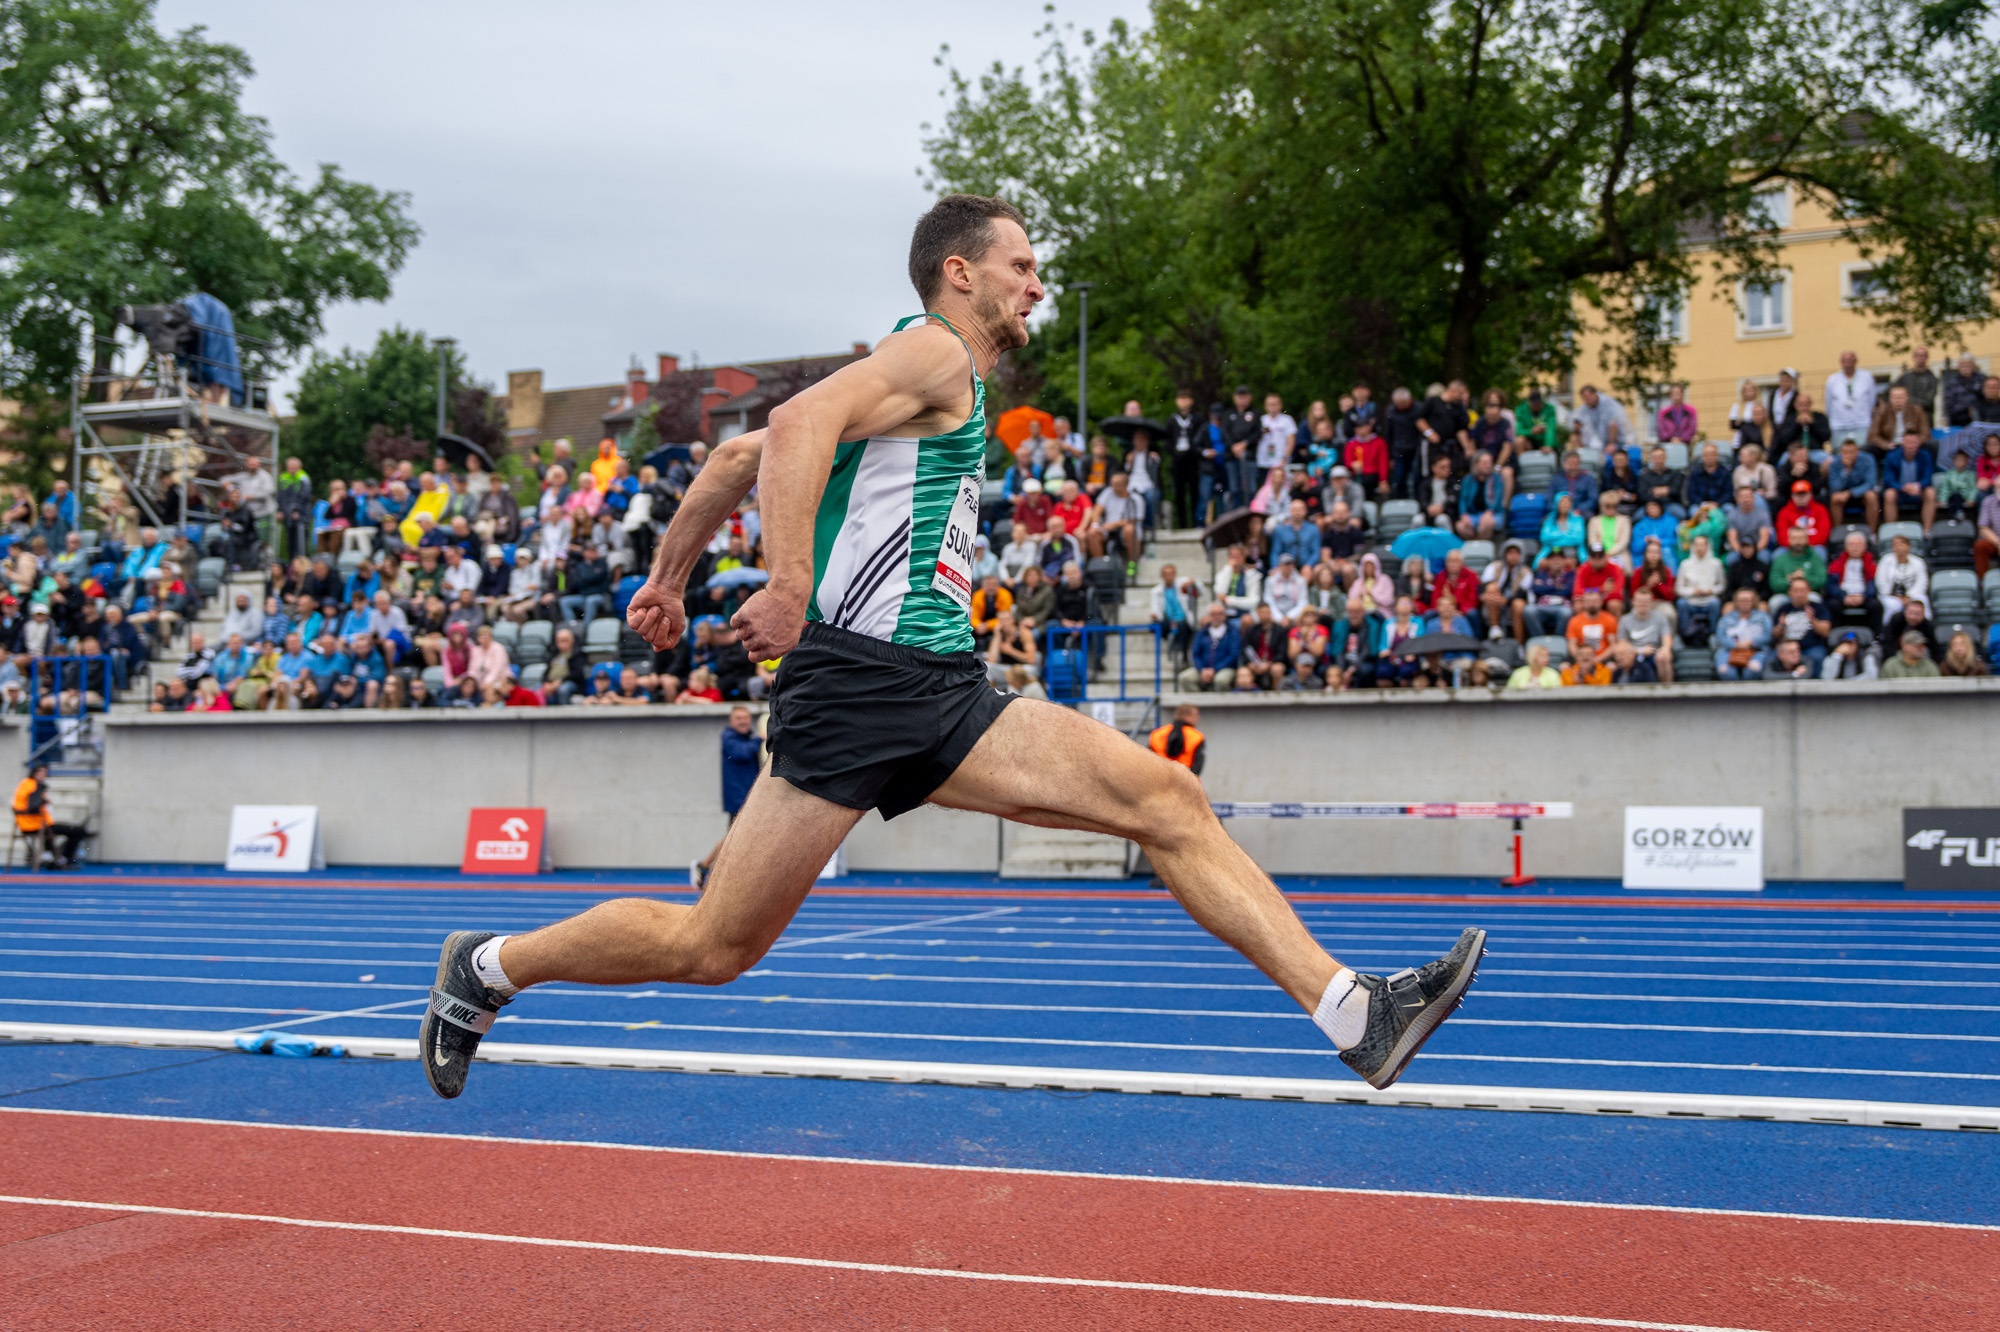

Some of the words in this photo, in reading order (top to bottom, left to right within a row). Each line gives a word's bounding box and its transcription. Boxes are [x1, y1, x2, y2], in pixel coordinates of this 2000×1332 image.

[1632, 822, 1753, 848] GORZÓW
[1906, 829, 1947, 850] 4F
[1940, 837, 2000, 867] FU
[444, 1002, 481, 1025] NIKE
